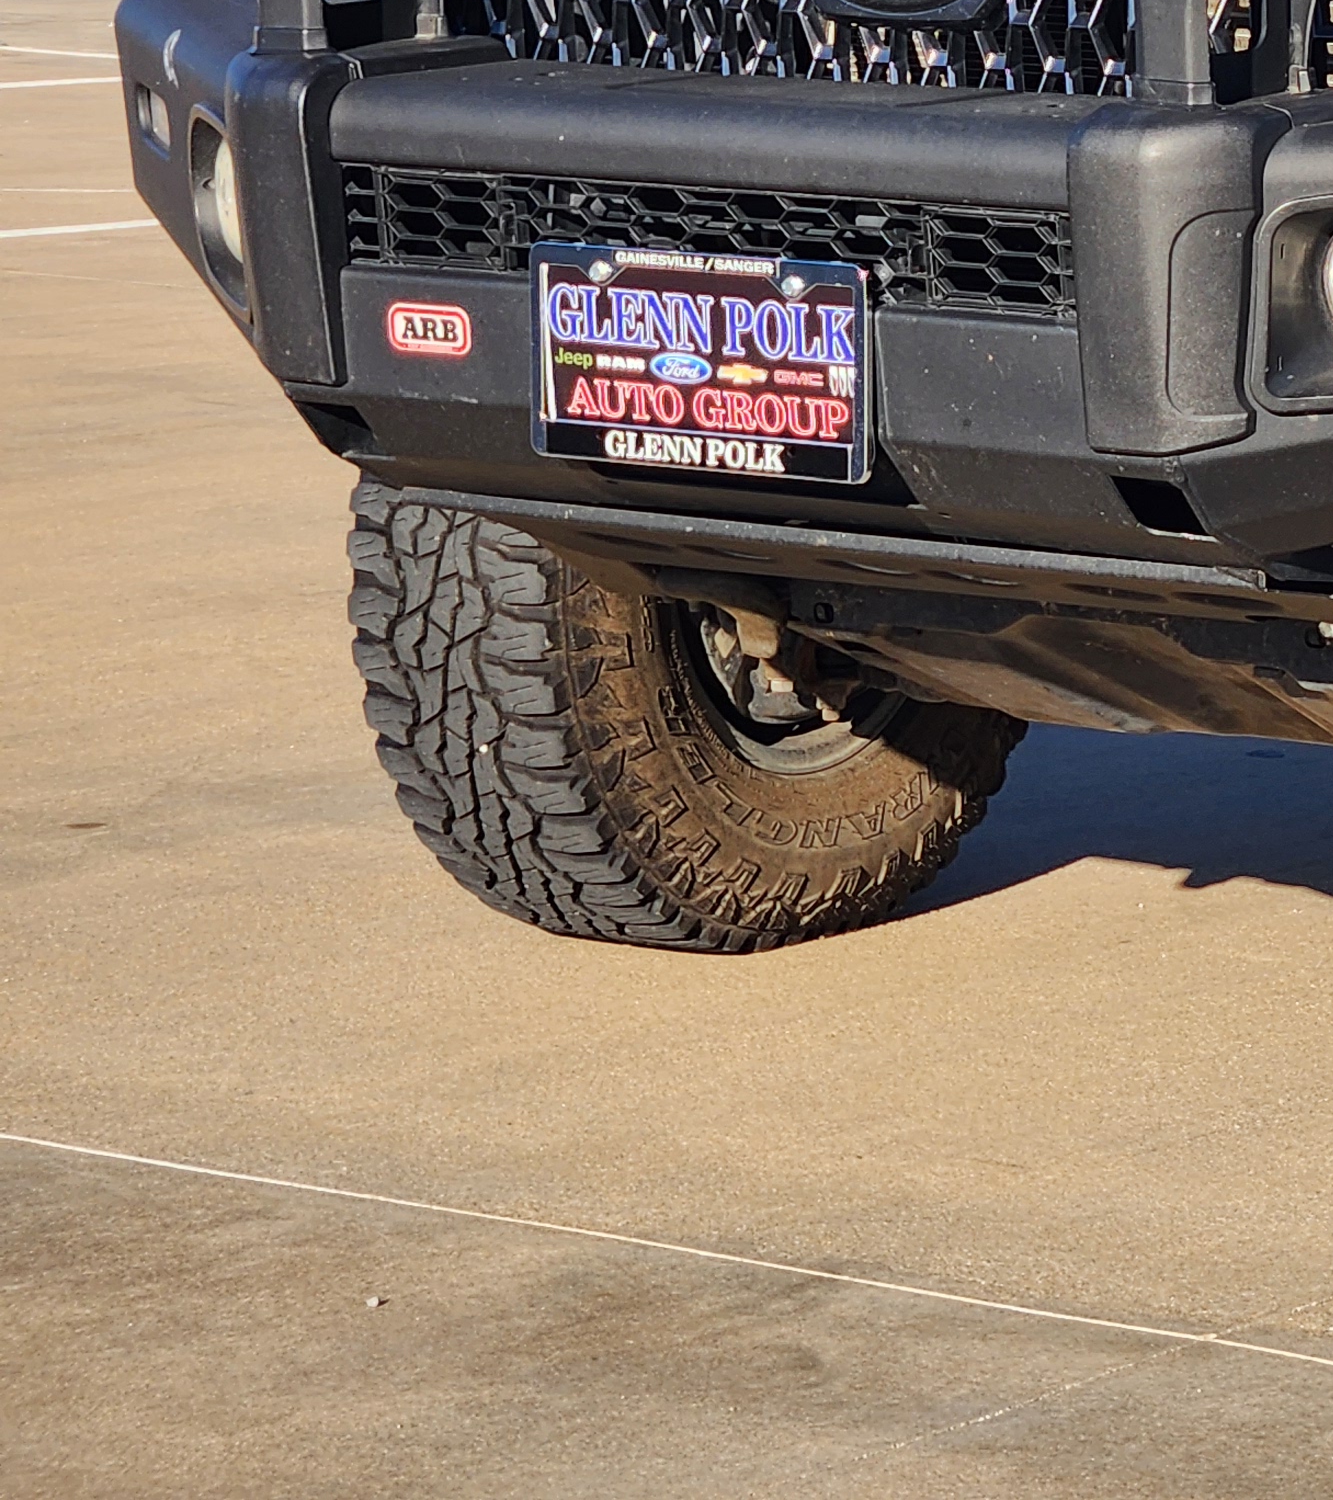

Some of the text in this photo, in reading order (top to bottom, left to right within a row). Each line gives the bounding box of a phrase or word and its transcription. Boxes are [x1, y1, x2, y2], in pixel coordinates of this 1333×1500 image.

[402, 315, 459, 342] ARB
[550, 281, 855, 366] GLENN POLK
[554, 347, 825, 387] Jeep RAM Ford GMC
[567, 375, 849, 440] AUTO GROUP
[604, 428, 785, 474] GLENN POLK
